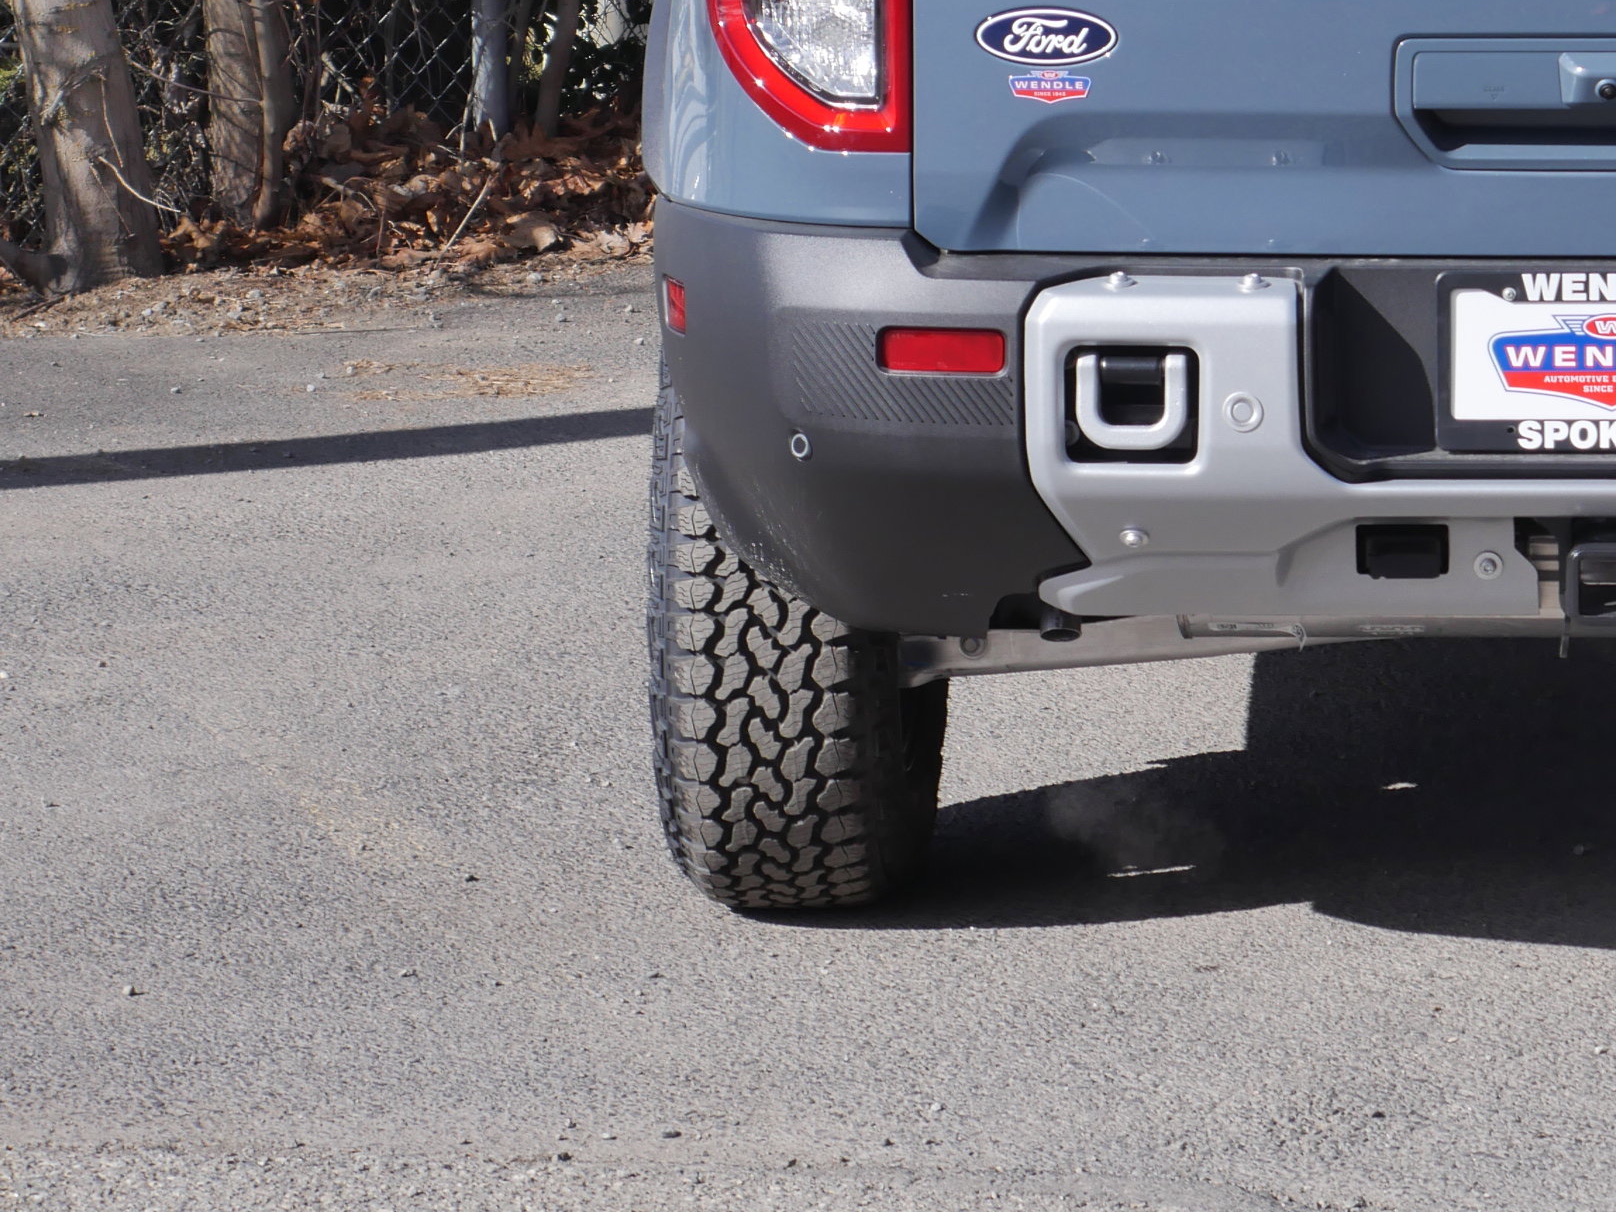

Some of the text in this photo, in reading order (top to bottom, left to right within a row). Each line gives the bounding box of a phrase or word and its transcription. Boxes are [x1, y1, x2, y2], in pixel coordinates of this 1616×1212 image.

[1003, 17, 1089, 54] Ford
[1014, 80, 1084, 89] WENDLE
[1543, 375, 1609, 383] AUTOMOTIVE
[1583, 385, 1613, 393] SINCE
